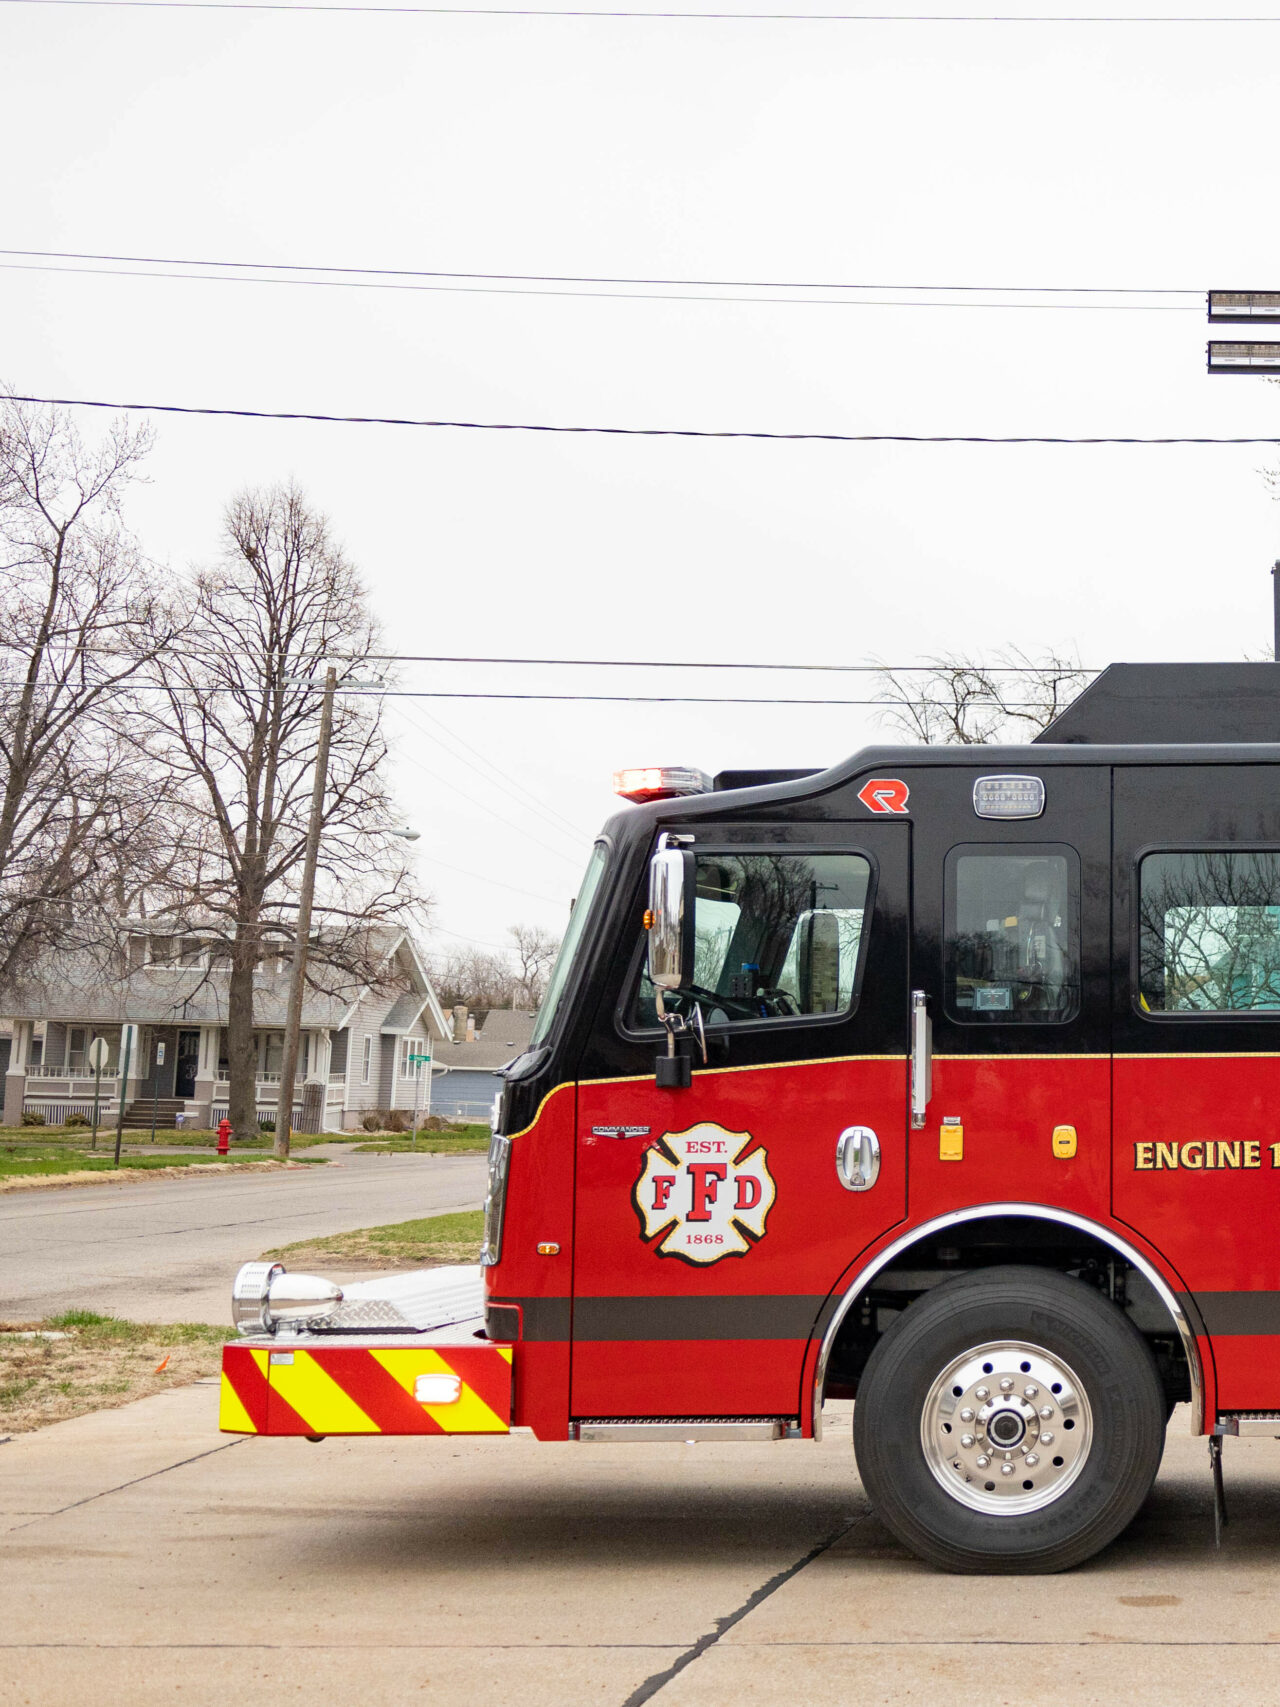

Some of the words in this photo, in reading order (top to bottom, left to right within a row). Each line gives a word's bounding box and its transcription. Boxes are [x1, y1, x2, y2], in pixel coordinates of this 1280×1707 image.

[685, 1141, 728, 1153] EST.
[1134, 1141, 1261, 1170] ENGINE
[686, 1234, 724, 1245] 1868
